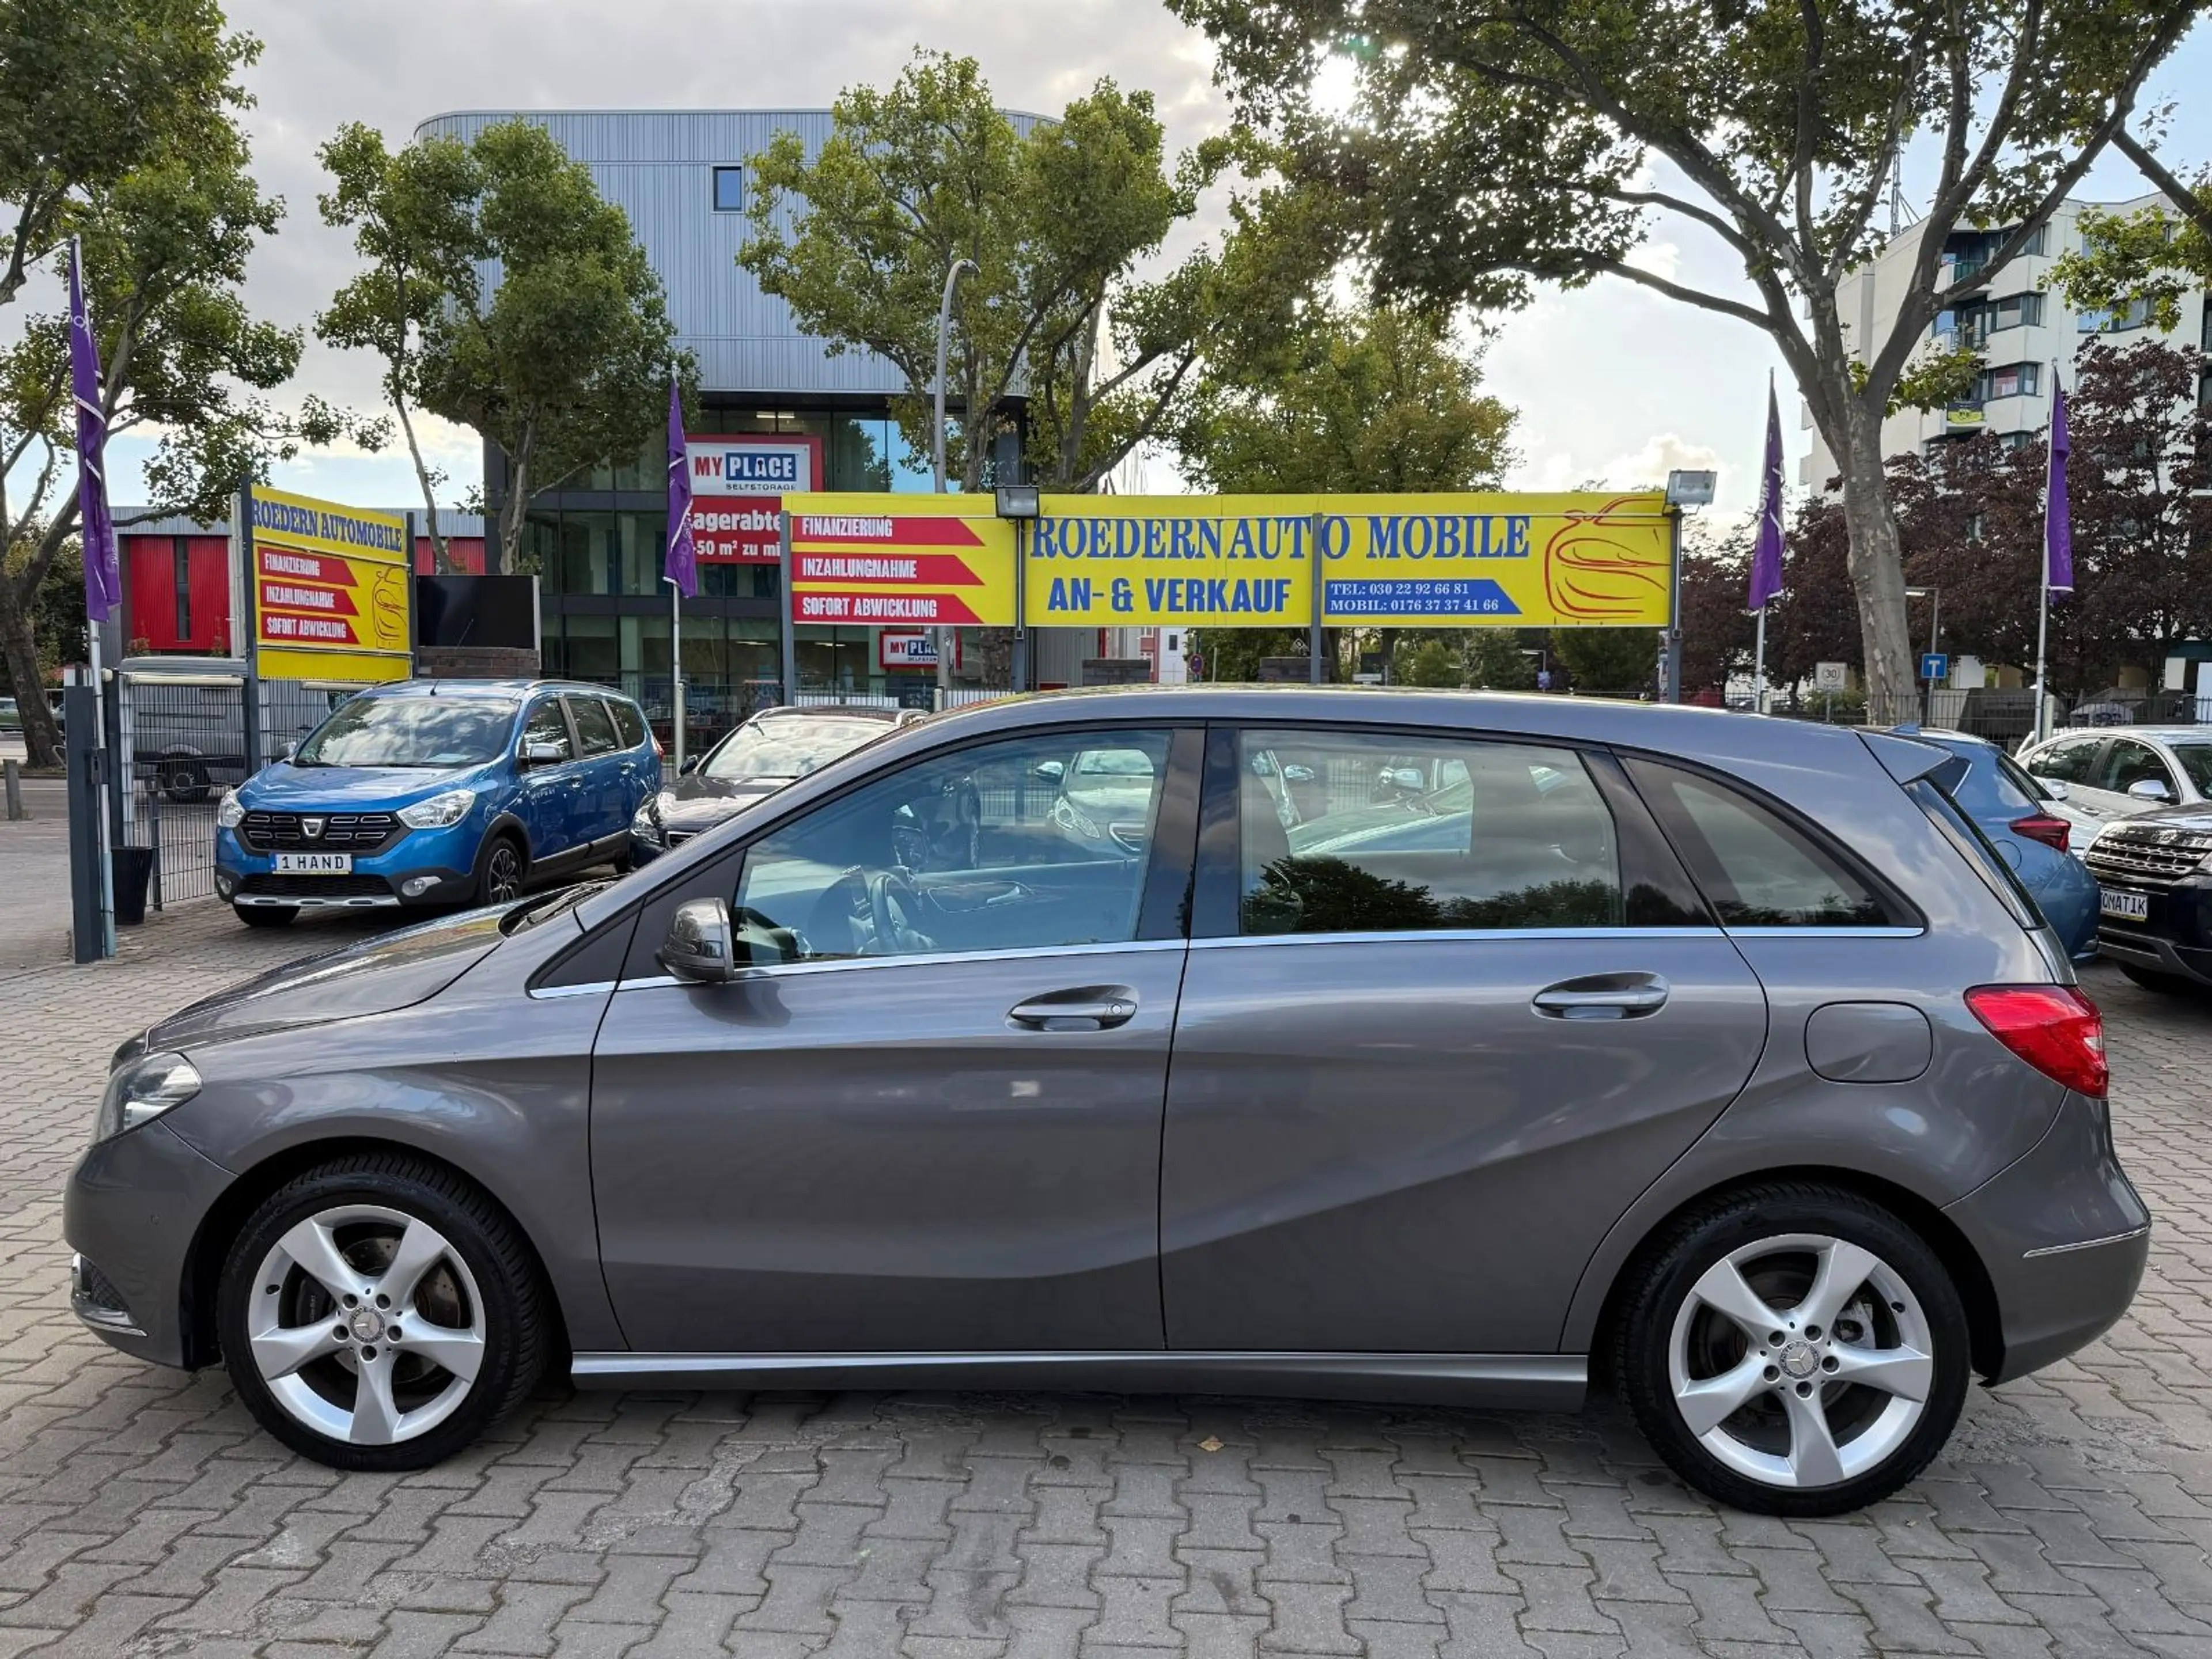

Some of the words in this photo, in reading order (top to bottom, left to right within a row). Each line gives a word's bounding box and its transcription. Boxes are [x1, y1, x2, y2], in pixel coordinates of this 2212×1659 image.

[695, 456, 722, 476] MY
[729, 457, 793, 478] PLACE
[252, 498, 317, 537] ROEDERN
[321, 513, 402, 552] AUTOMOBILE
[693, 509, 781, 532] agerabte
[802, 517, 892, 537] FINANZIERUNG
[1030, 517, 1224, 558] ROEDERN
[742, 544, 758, 555] zu
[264, 553, 320, 576] FINANZIERUNG
[802, 558, 918, 578] INZAHLUNGNAHME
[266, 585, 335, 608] INZAHLUNGNAHME
[1048, 578, 1104, 611] AN-
[1111, 578, 1134, 612] &
[1145, 578, 1291, 612] VERKAUF
[1331, 583, 1366, 595] TEL:
[1369, 583, 1393, 594] 030
[1396, 583, 1411, 594] 22
[1415, 583, 1430, 594] 92
[1434, 583, 1450, 594] 66
[1454, 583, 1468, 594] 81
[802, 597, 850, 615] SOFORT
[854, 597, 937, 618] ABWICKLUNG
[1331, 600, 1387, 611] MOBIL:
[1391, 600, 1421, 611] 0176
[1425, 600, 1441, 611] 37
[1445, 600, 1460, 611] 37
[1464, 600, 1479, 611] 41
[1483, 600, 1499, 611] 66
[267, 616, 297, 635] SOFORT
[299, 619, 346, 638] ABWICKLUNG
[890, 642, 907, 653] MY
[910, 641, 938, 654] PLA
[282, 856, 290, 869] 1
[297, 856, 344, 869] HAND
